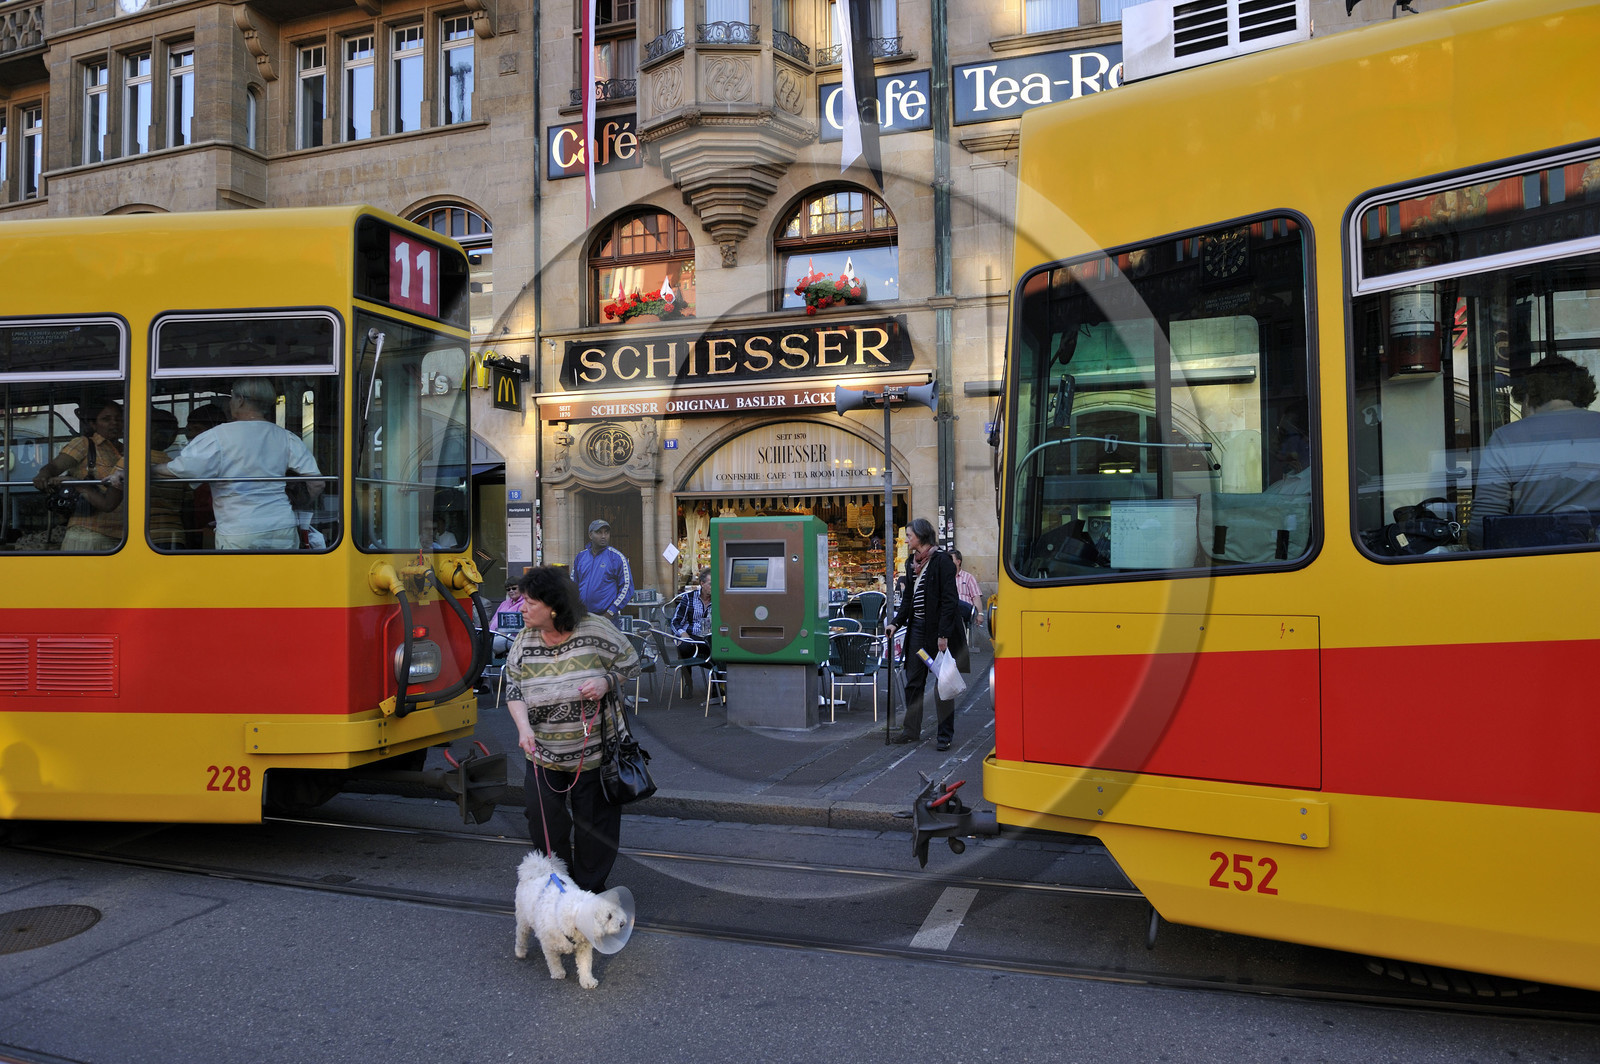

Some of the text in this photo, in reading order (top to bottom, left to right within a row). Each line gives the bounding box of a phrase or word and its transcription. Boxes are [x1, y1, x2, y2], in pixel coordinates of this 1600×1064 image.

[552, 121, 638, 168] Café
[395, 241, 431, 305] 11
[579, 328, 891, 382] SCHIESSER
[591, 402, 658, 416] SCHIESSER
[665, 398, 729, 412] ORIGINAL
[736, 395, 786, 408] BASLER
[794, 432, 807, 440] 1870
[757, 443, 828, 464] SCHIESSER
[715, 472, 761, 481] CONFISERIE
[792, 471, 809, 479] TEA
[810, 470, 835, 478] ROOM
[206, 765, 252, 792] 228
[1208, 851, 1279, 896] 252
